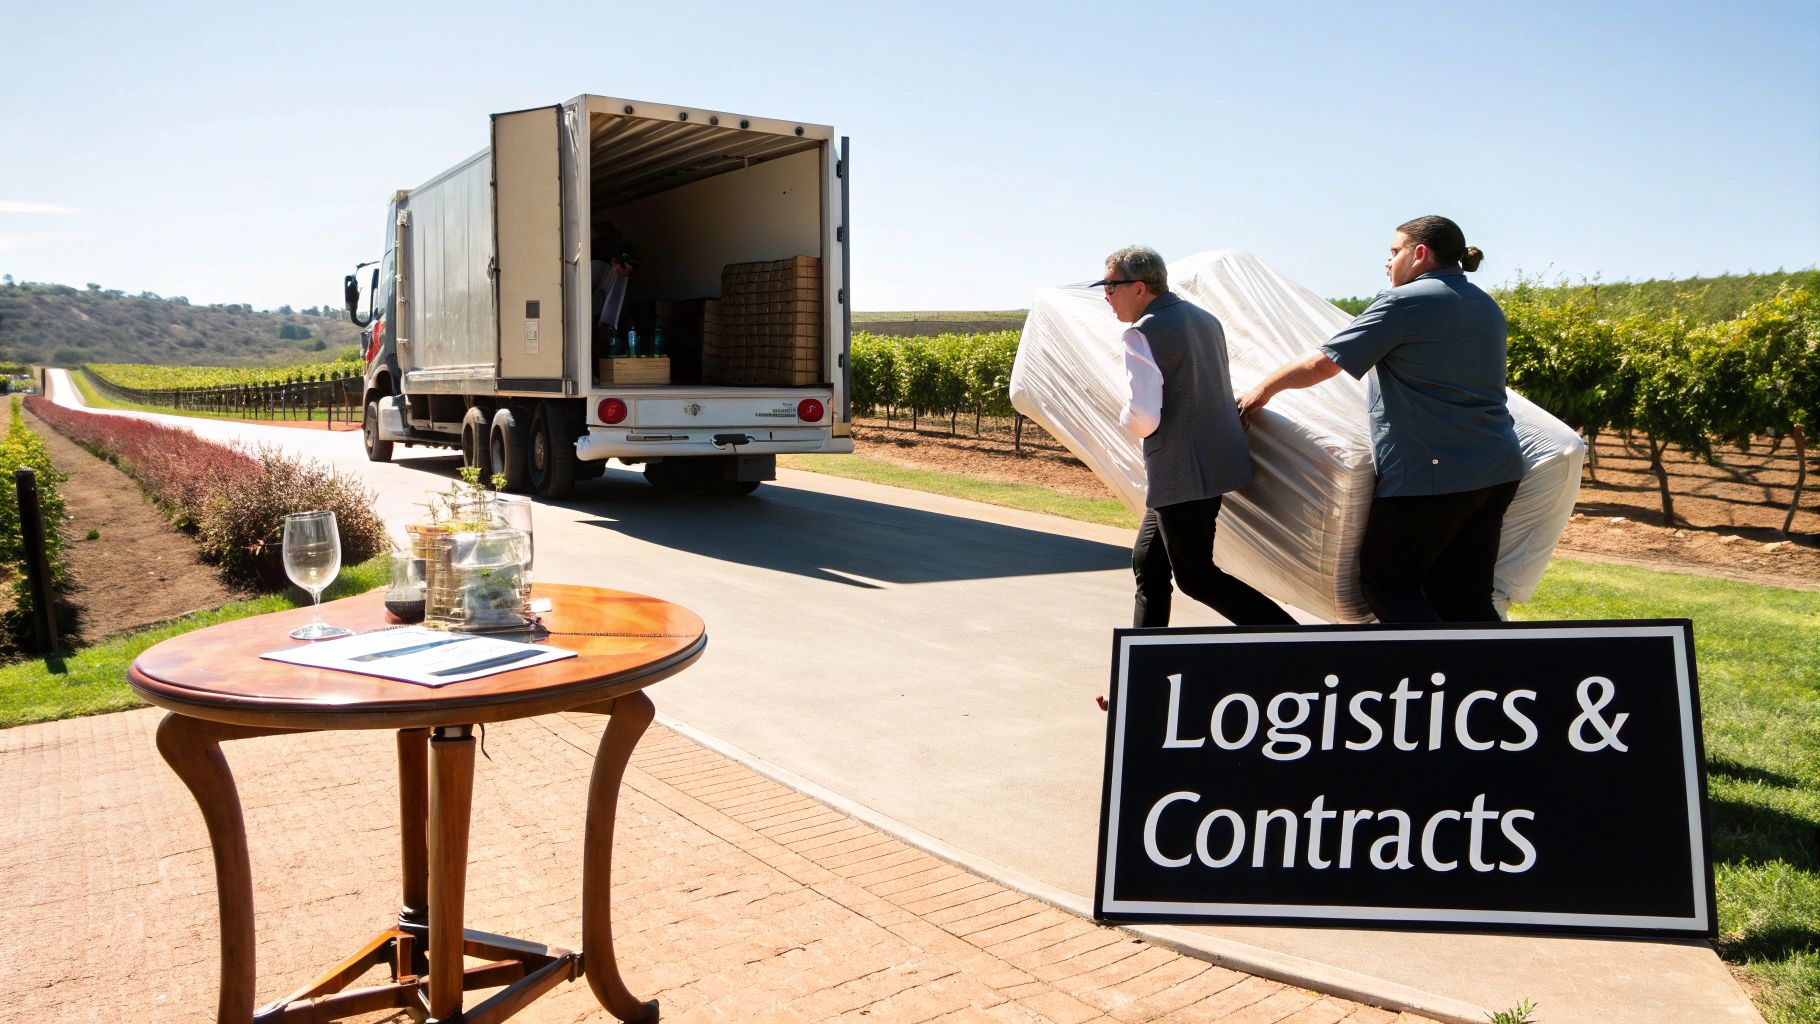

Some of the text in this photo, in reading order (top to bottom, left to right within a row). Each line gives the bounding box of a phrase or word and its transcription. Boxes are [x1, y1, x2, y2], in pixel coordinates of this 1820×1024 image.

[1161, 672, 1630, 761] Logistics &
[1143, 791, 1537, 873] Contracts
